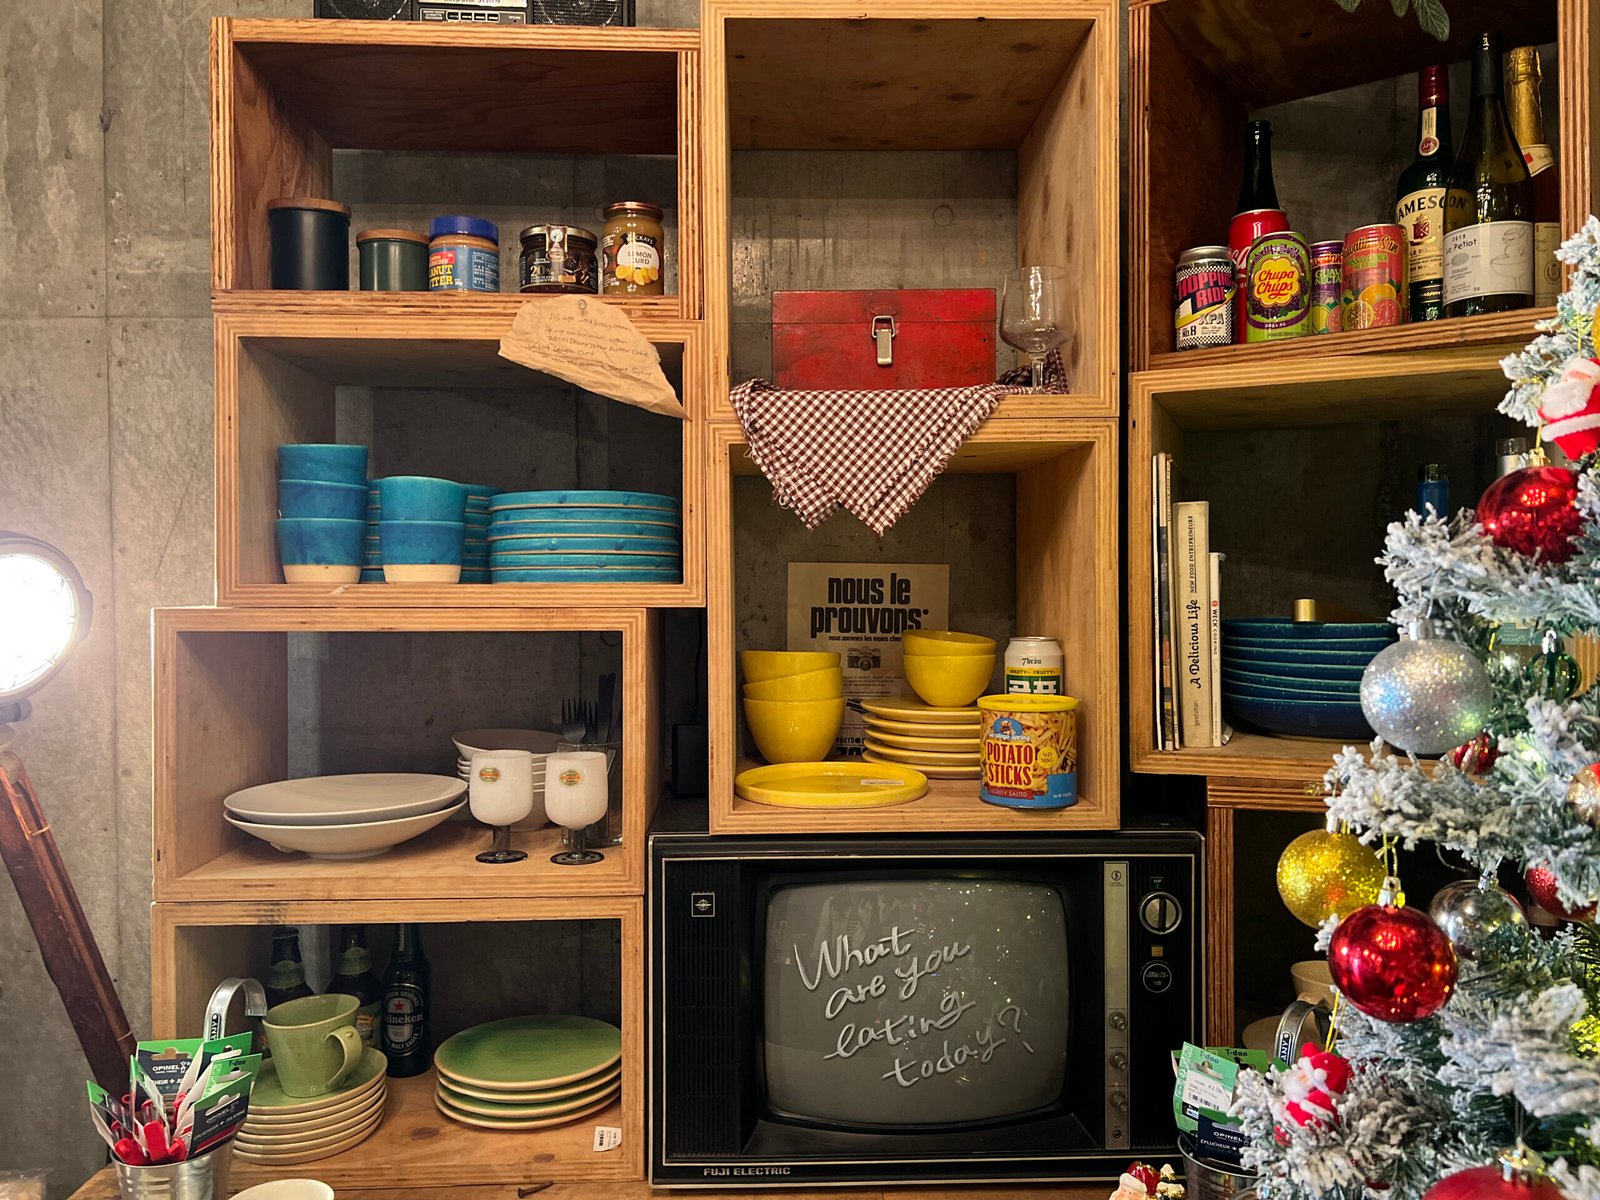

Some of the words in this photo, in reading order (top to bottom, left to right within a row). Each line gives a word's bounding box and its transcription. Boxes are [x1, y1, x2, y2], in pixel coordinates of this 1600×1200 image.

[1398, 195, 1467, 219] AMESON
[1453, 238, 1477, 251] Petiot
[1258, 269, 1295, 282] Chupa
[1256, 281, 1293, 299] Chups
[828, 577, 884, 604] nous
[890, 573, 911, 604] le
[1186, 599, 1201, 620] Life
[1188, 622, 1201, 676] Delicious
[1190, 677, 1202, 689] A
[987, 742, 1034, 765] POTATO
[988, 763, 1032, 786] STICKS
[793, 926, 917, 990] What
[825, 975, 886, 1019] are
[895, 942, 971, 1000] you
[385, 1012, 423, 1024] eineken
[823, 991, 976, 1059] eating
[881, 1005, 1034, 1087] today?
[1225, 1048, 1248, 1057] T-duo
[1200, 1050, 1219, 1064] T-duo
[1213, 1131, 1243, 1142] OPINEL
[703, 1168, 730, 1176] FUJI
[733, 1167, 791, 1176] ELECTRIC
